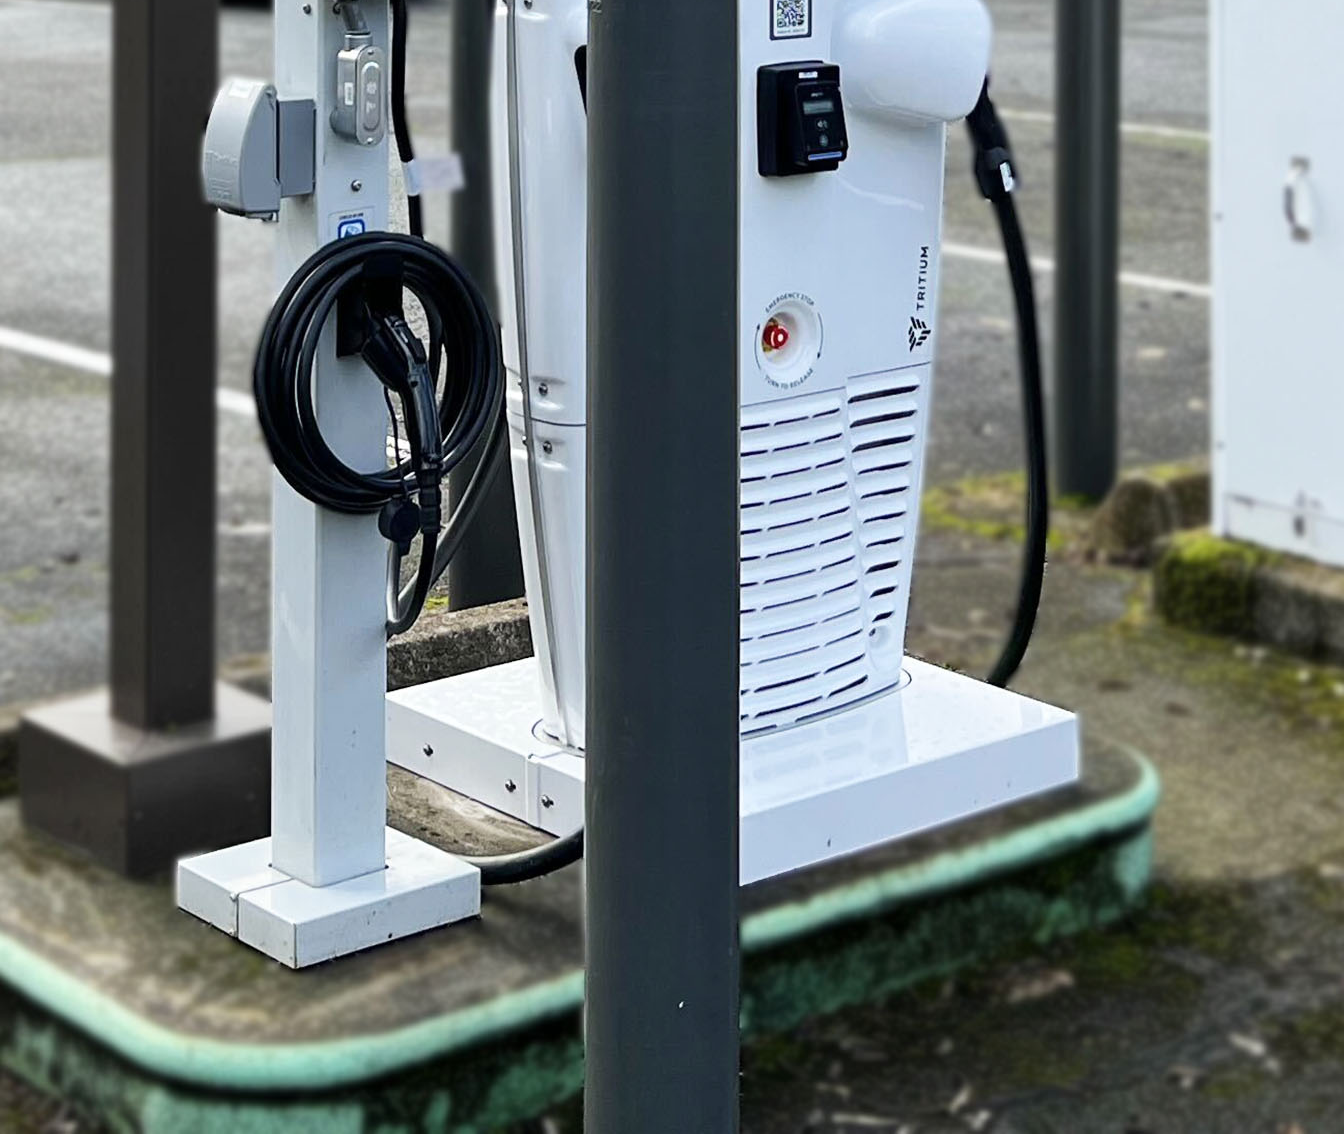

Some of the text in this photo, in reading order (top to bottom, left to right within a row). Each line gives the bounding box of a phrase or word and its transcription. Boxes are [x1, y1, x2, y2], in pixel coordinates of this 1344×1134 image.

[916, 245, 929, 312] TRITIUM
[765, 292, 815, 313] EMERGENCY STOP
[764, 374, 780, 388] TURN
[789, 367, 814, 389] RELEASE
